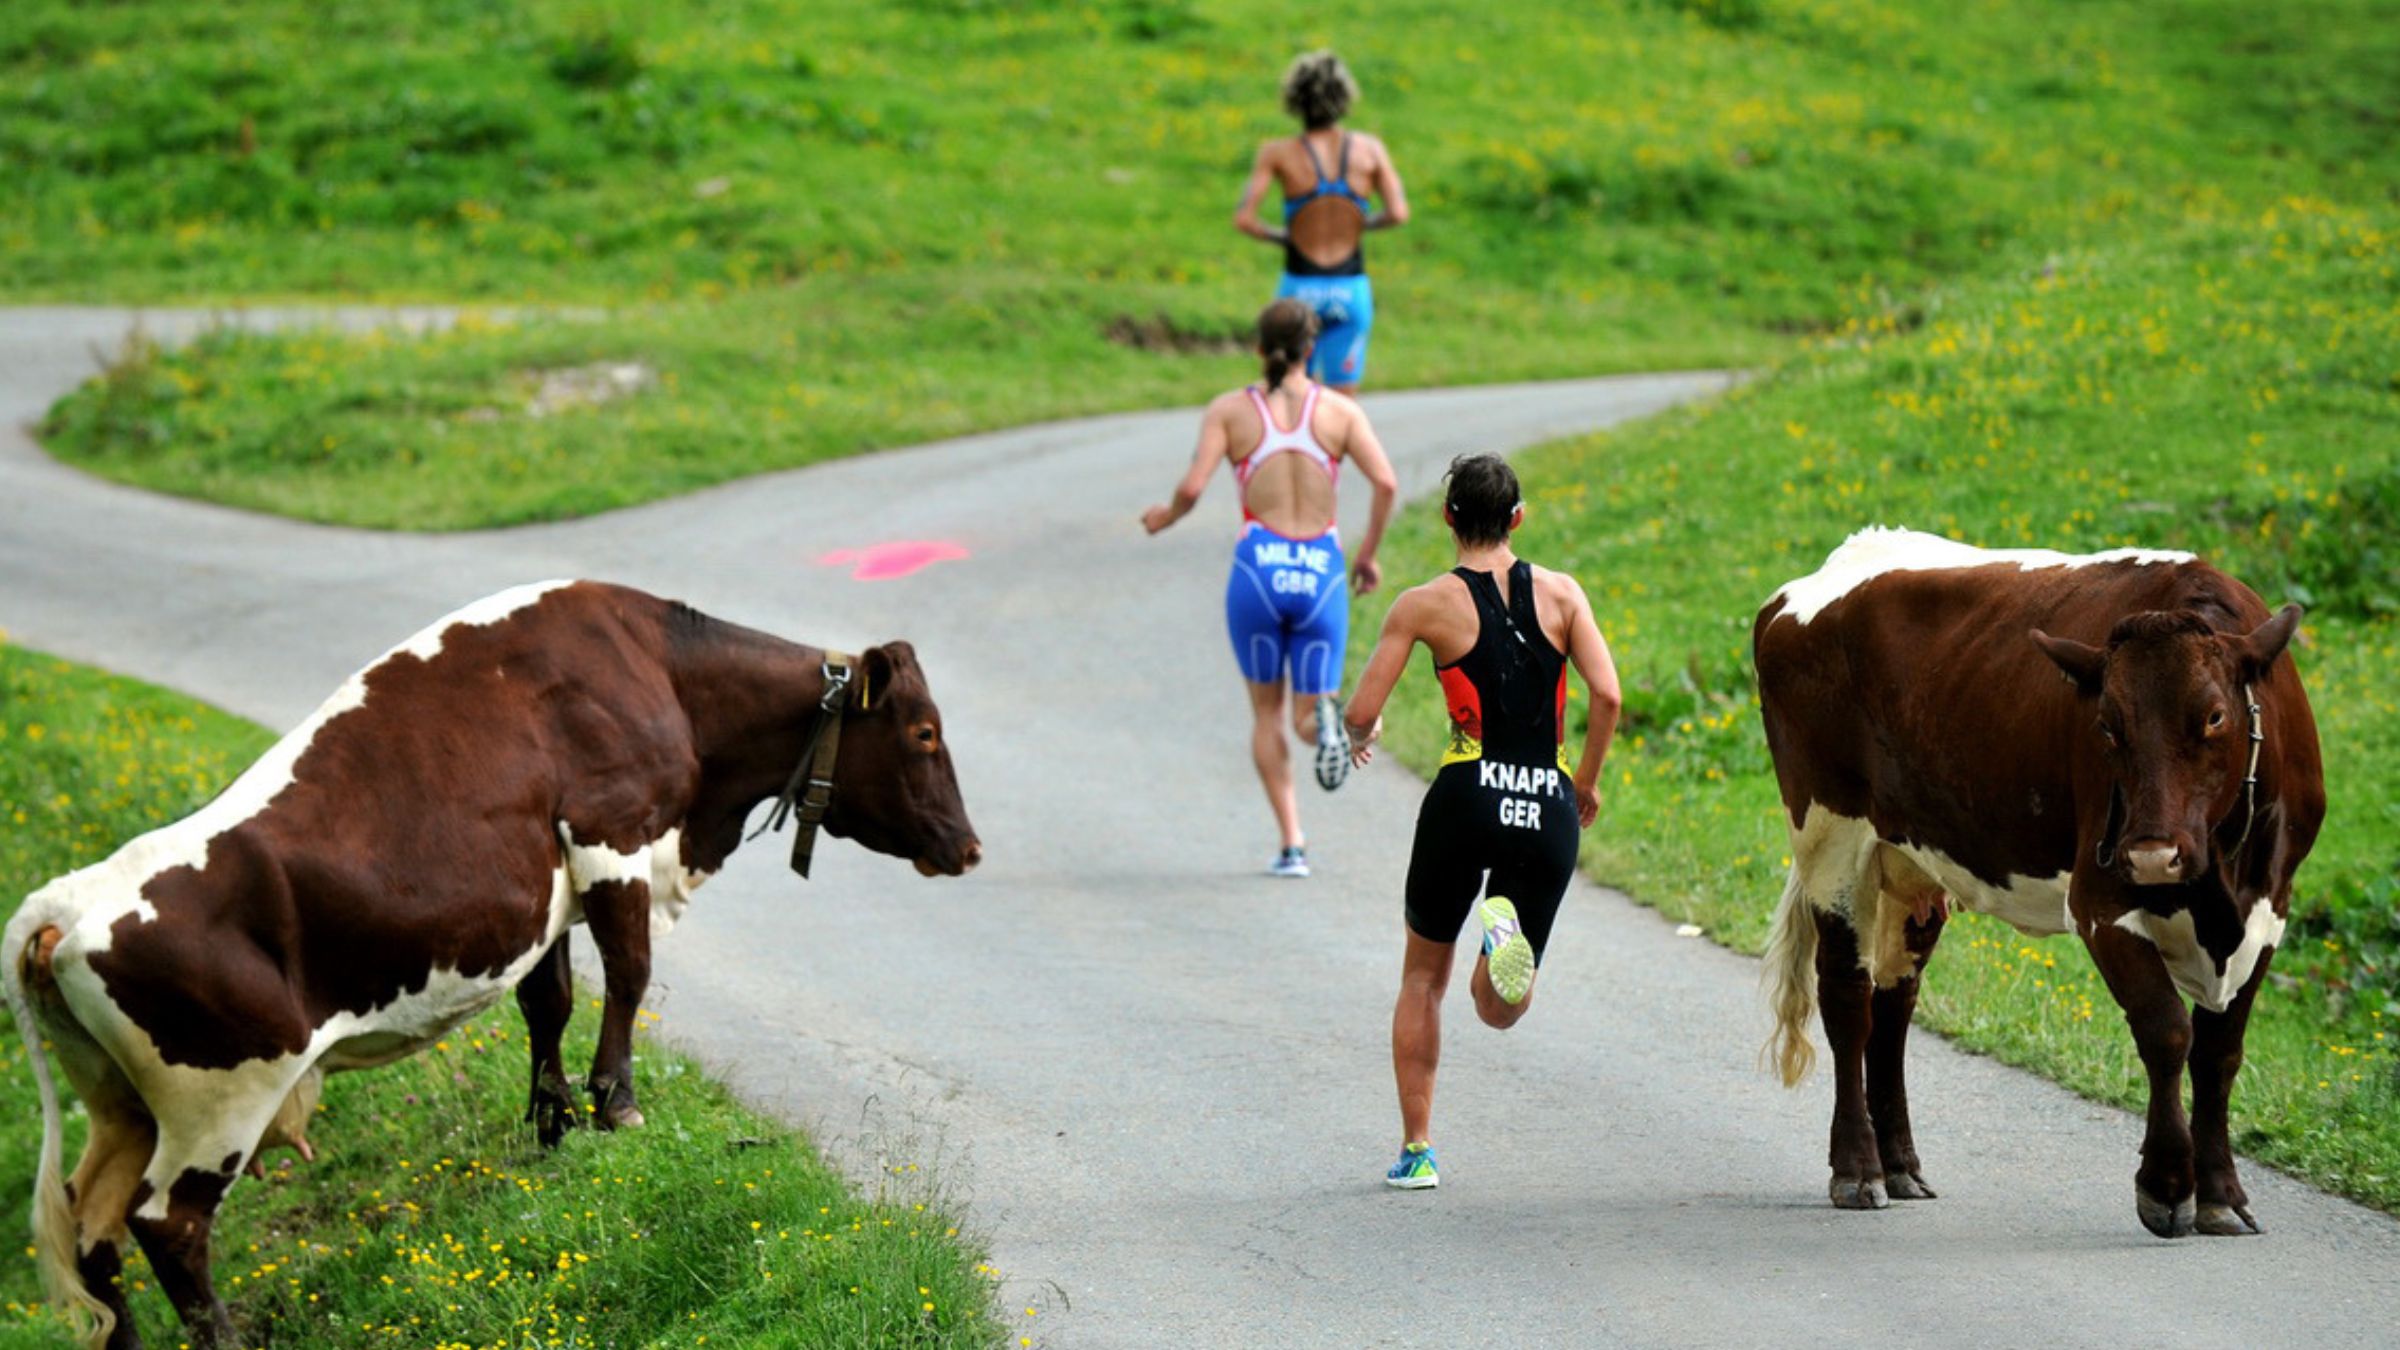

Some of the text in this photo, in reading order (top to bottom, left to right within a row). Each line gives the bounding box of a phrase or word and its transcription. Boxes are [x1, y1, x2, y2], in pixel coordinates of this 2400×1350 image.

[1255, 543, 1330, 575] MILNE
[1272, 569, 1318, 598] GBR
[1480, 759, 1559, 797] KNAPP
[1500, 797, 1541, 830] GER
